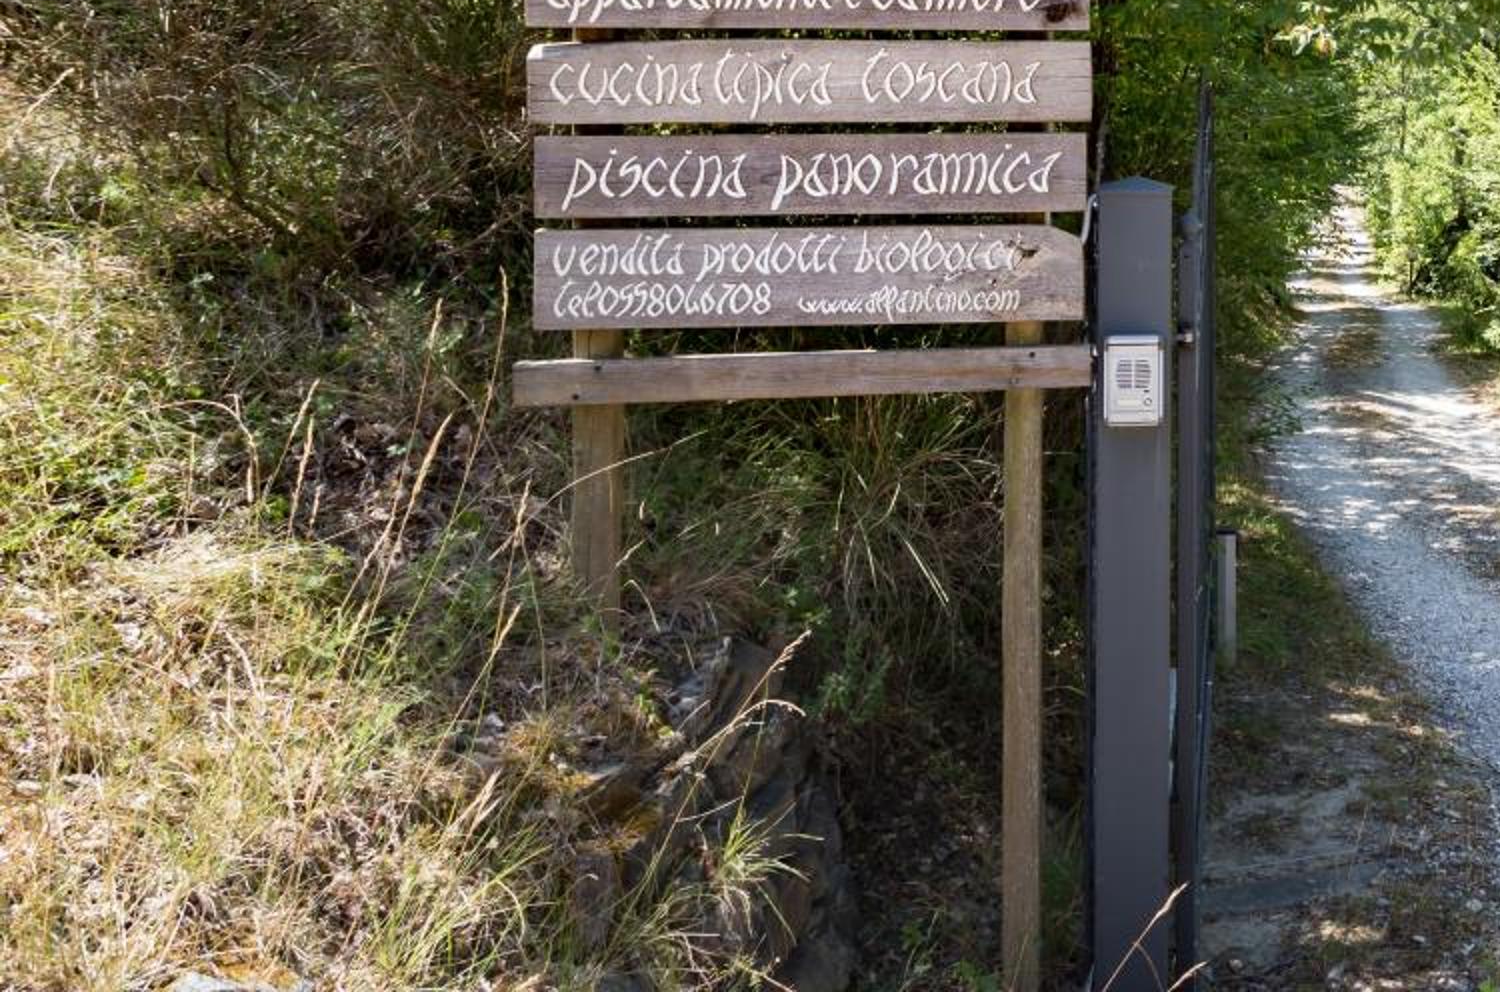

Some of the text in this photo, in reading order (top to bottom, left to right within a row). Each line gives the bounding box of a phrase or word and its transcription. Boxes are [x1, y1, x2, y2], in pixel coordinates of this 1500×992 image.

[549, 48, 1040, 119] cucina tipica toscana
[561, 144, 1062, 211] piscina panoramica
[553, 229, 1023, 282] vendita prodotti biologici
